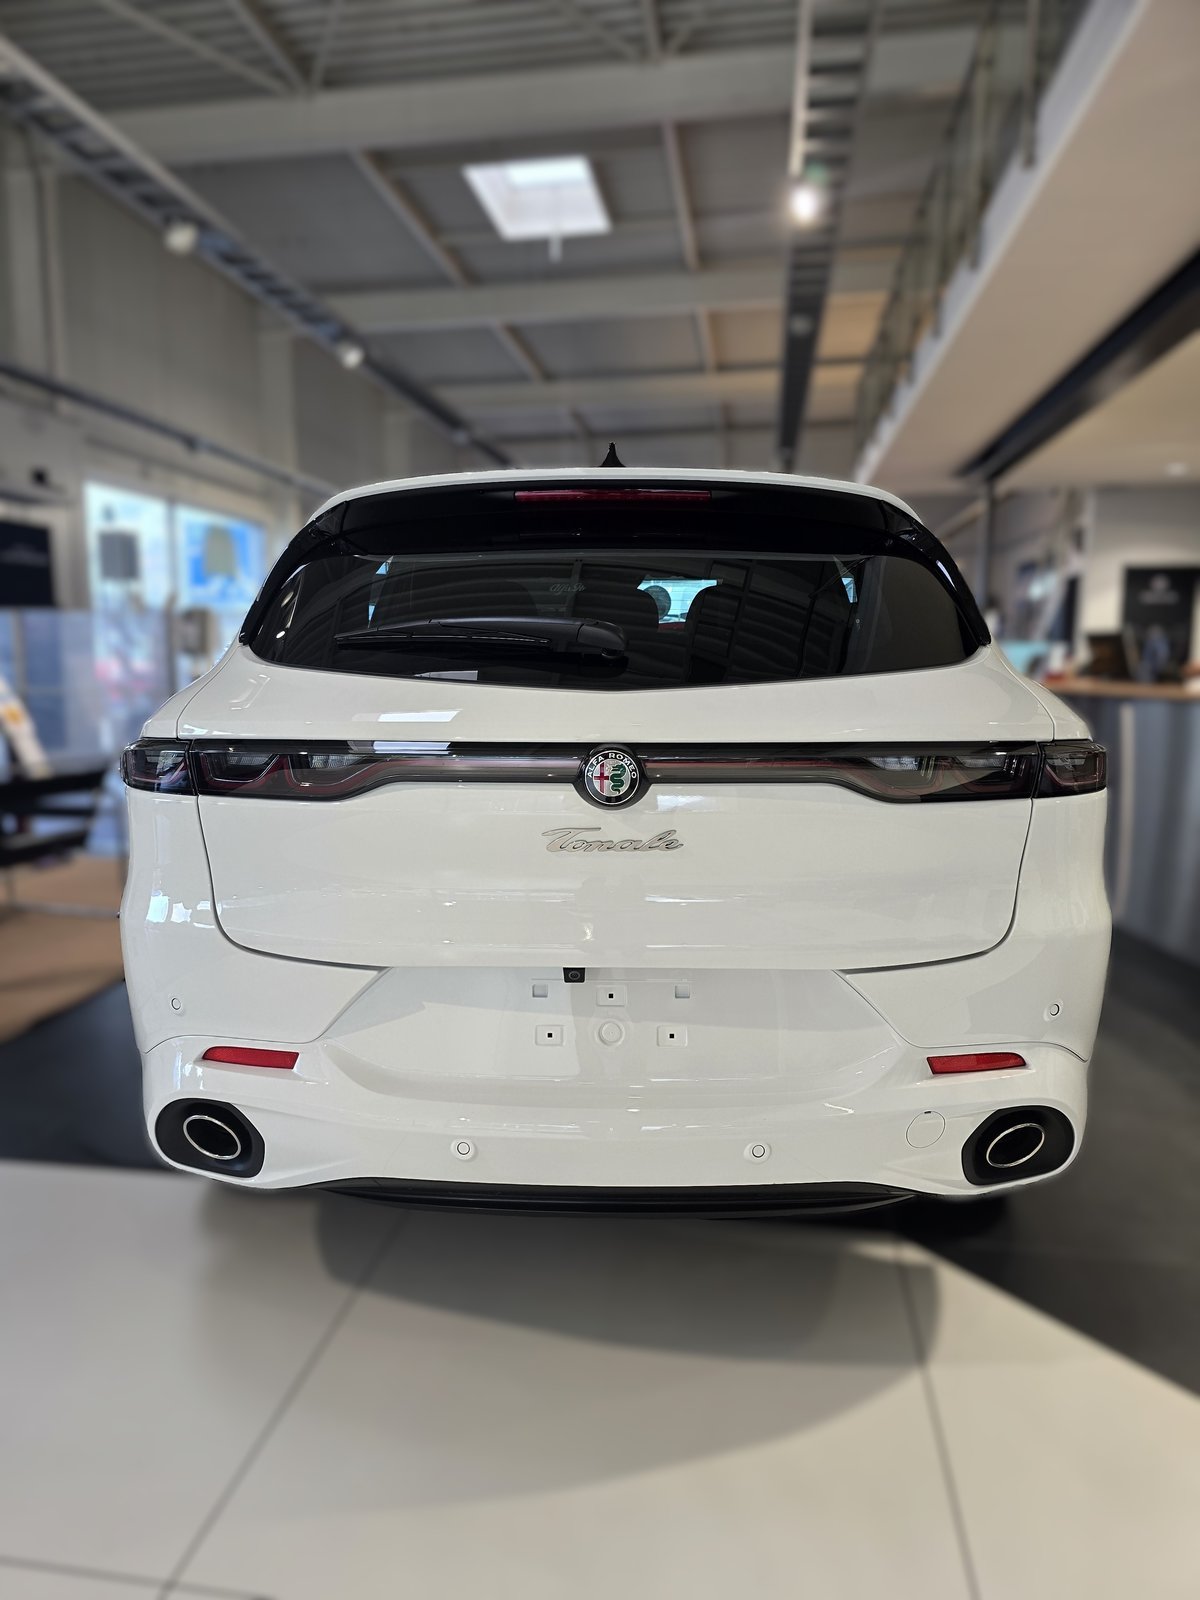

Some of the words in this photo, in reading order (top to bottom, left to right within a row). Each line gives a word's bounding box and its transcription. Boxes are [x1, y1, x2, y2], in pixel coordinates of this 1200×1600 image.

[587, 755, 605, 778] ALFA
[608, 752, 637, 779] ROMEO
[541, 827, 685, 853] Tonale
